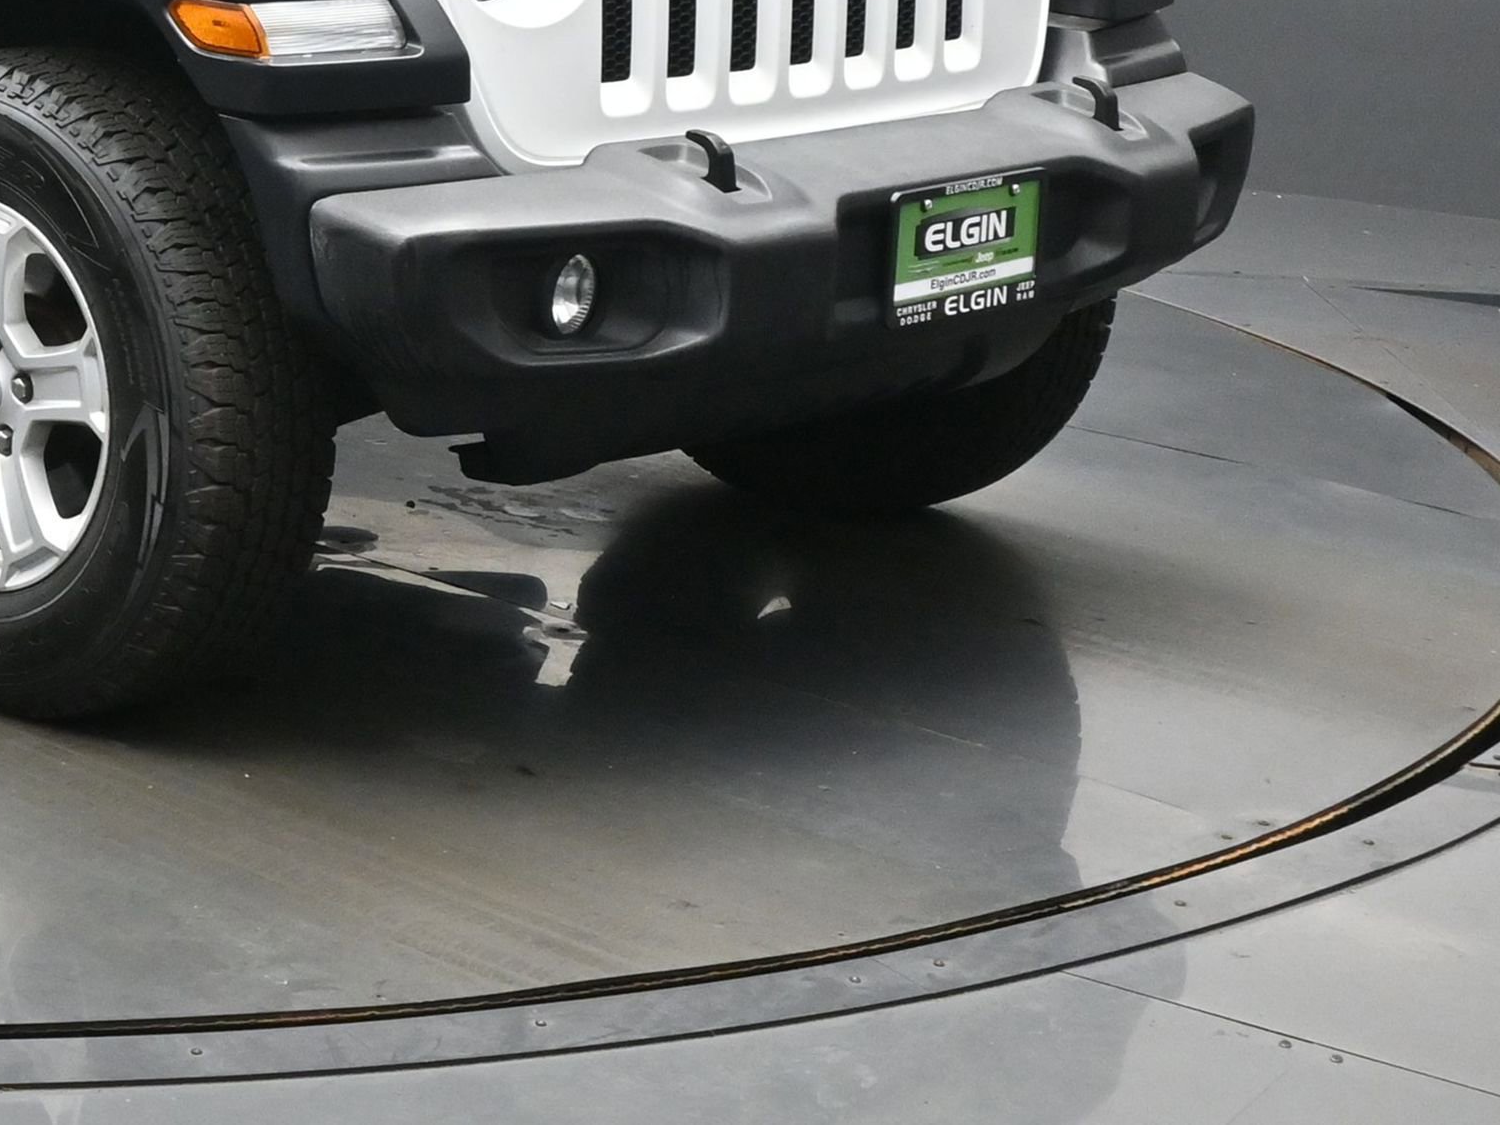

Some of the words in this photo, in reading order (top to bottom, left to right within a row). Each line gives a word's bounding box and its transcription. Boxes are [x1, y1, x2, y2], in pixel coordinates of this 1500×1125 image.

[924, 209, 1008, 253] ELGIN
[930, 268, 997, 291] ElginCDJR.com
[1016, 280, 1036, 292] JEEP
[897, 300, 938, 317] CHRYSLER
[944, 285, 1008, 316] ELGIN
[900, 312, 933, 327] DODGE
